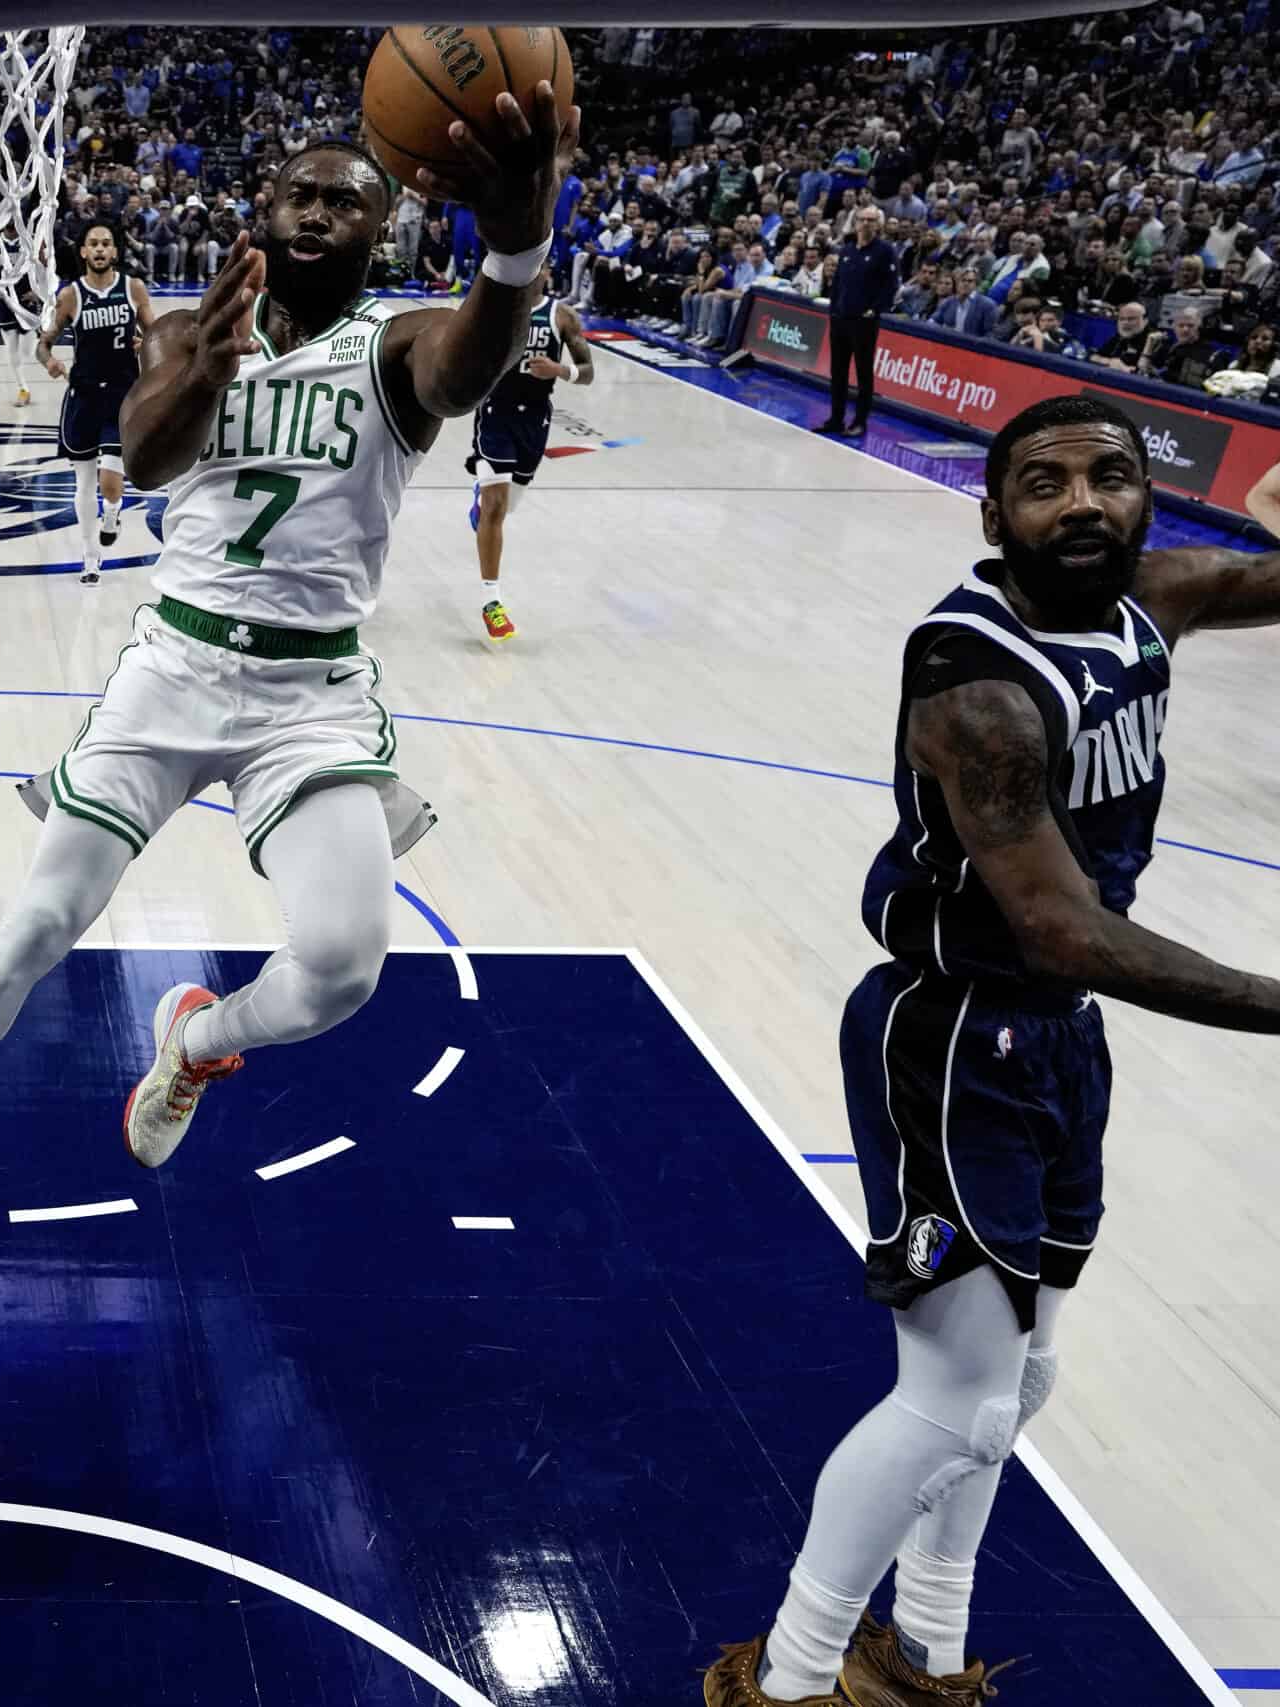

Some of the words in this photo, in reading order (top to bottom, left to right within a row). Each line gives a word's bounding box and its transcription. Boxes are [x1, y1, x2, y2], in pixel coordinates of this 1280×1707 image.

[113, 326, 126, 349] 2
[329, 349, 365, 363] PRINT
[331, 335, 366, 351] VISTA
[873, 348, 919, 387] Hotel
[915, 357, 948, 397] like
[946, 378, 961, 400] a
[956, 381, 997, 413] pro
[200, 379, 364, 470] ELTICS
[224, 469, 302, 568] 7
